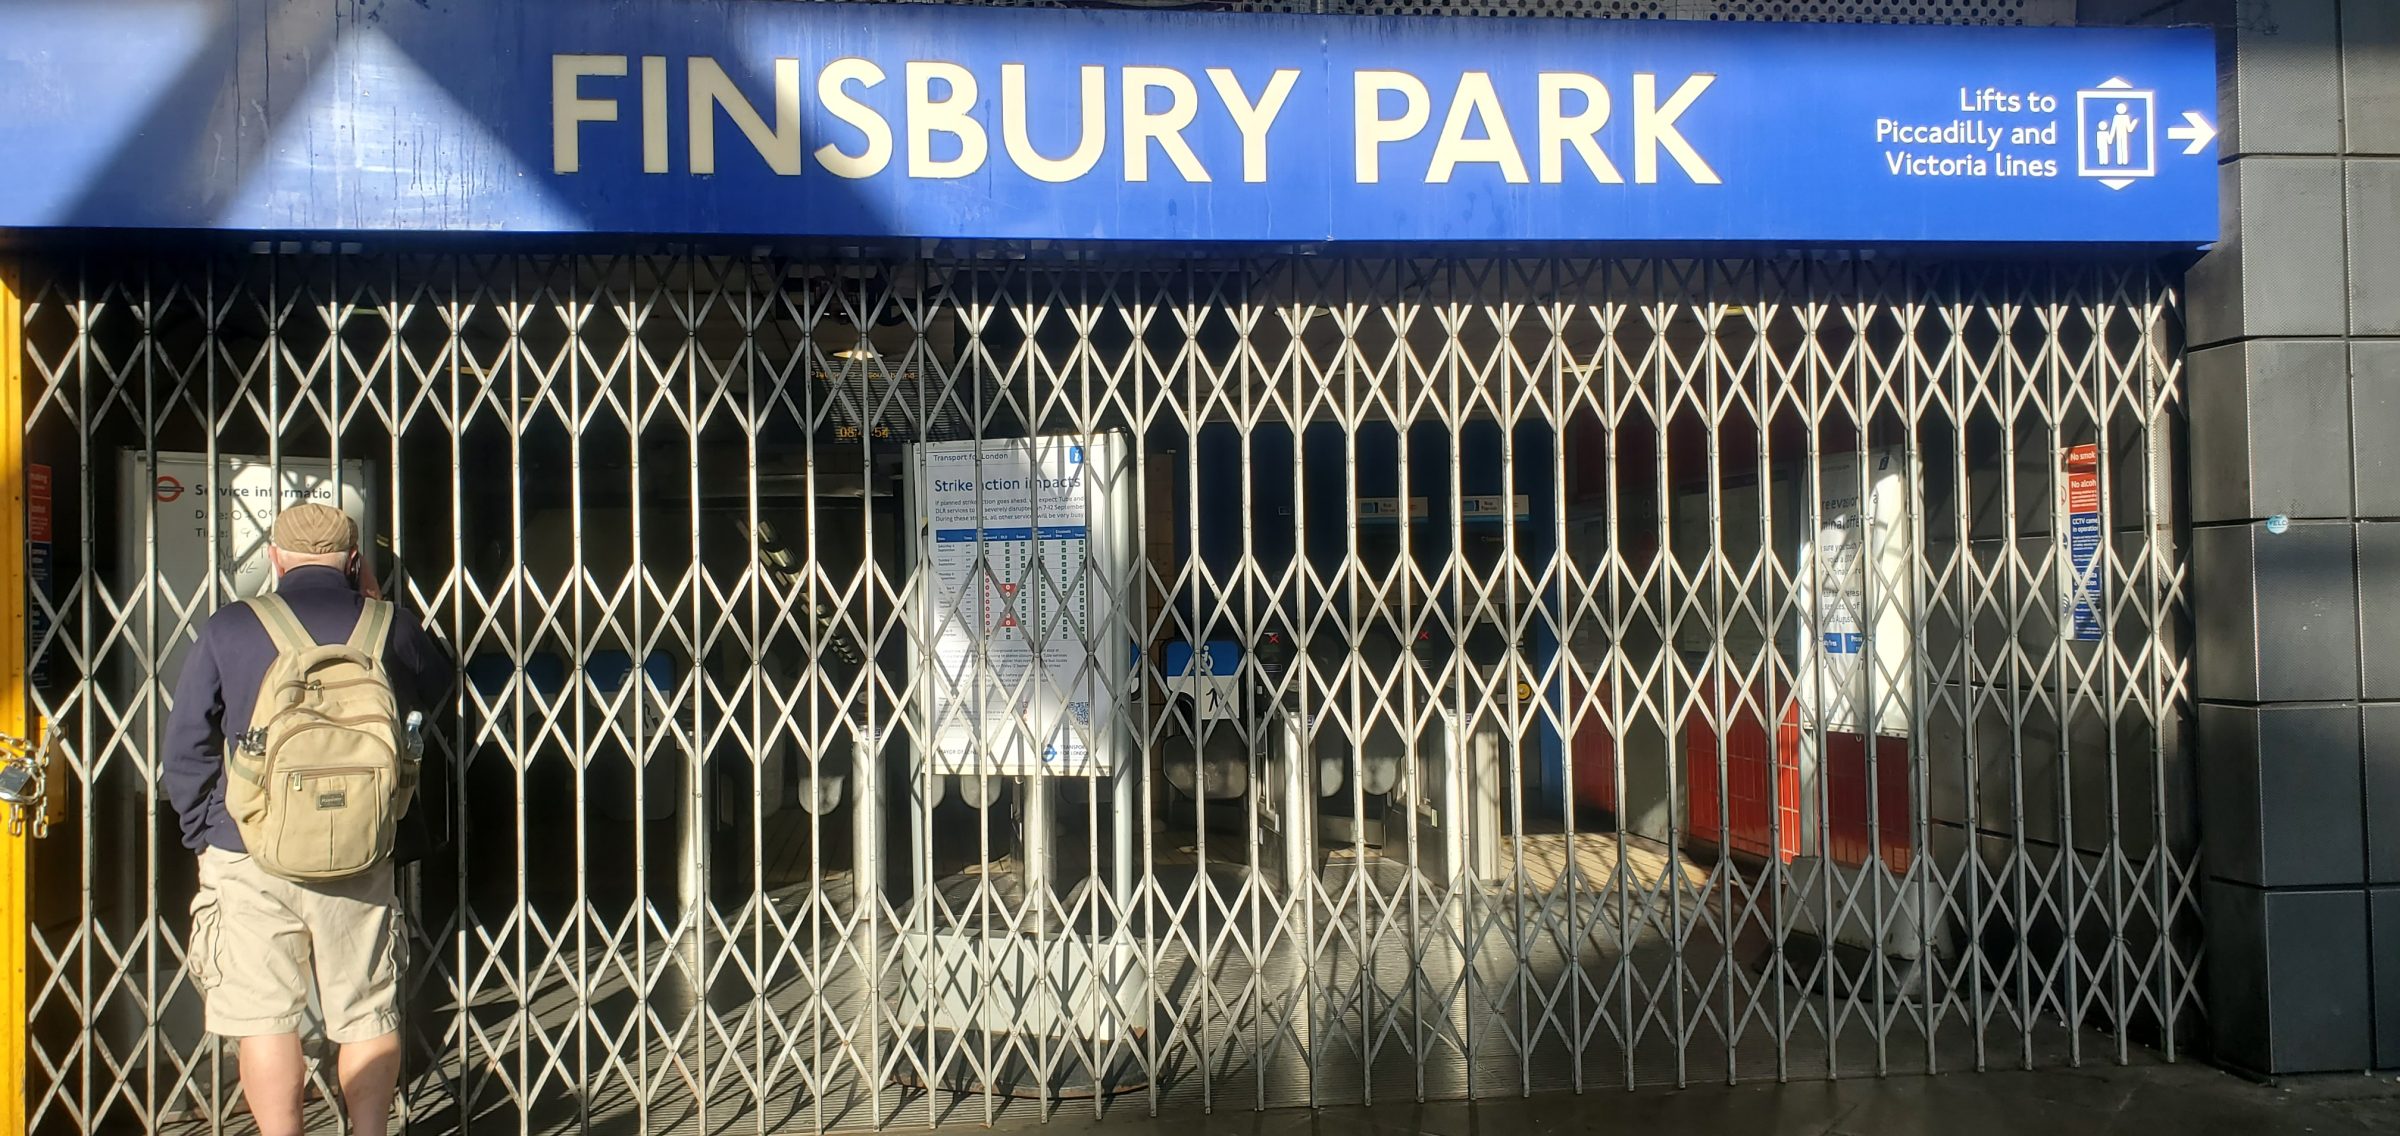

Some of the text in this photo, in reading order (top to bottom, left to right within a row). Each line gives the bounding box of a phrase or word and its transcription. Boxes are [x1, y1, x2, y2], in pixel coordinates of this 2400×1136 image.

[1960, 88, 2056, 112] Lifts to
[552, 54, 1722, 184] FINSBURY PARK
[1876, 118, 2056, 151] Piccadilly and
[1885, 151, 2057, 177] Victoria lines
[933, 452, 1008, 462] Transport fo London
[2080, 451, 2098, 460] smok
[935, 479, 973, 492] Strike
[980, 478, 1020, 491] ction
[2080, 479, 2097, 488] alcoh
